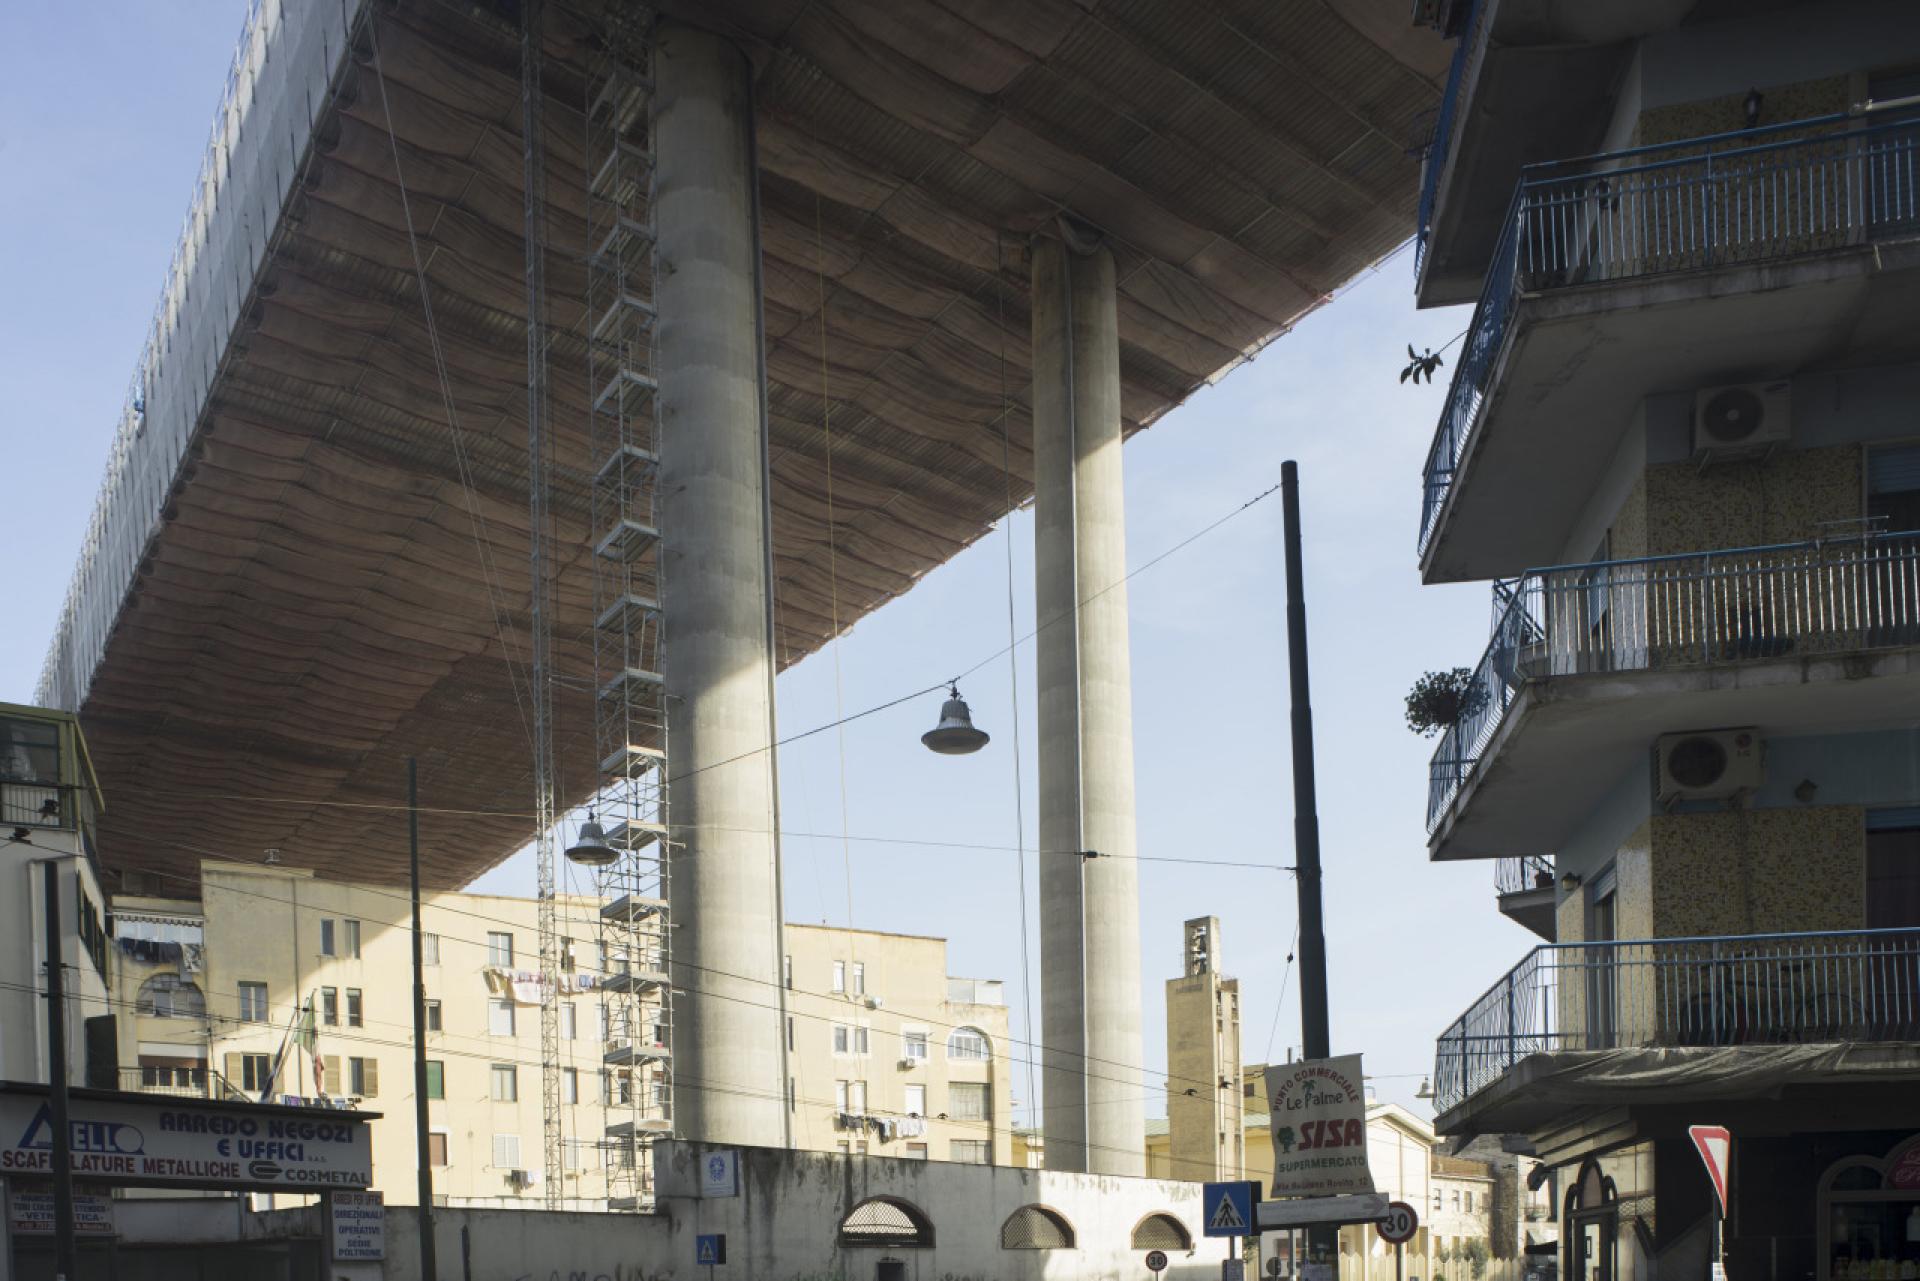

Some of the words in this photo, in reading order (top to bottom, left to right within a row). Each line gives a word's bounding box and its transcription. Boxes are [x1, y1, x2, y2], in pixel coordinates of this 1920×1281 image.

[1273, 1080, 1294, 1111] PUNTO
[1294, 1067, 1359, 1104] COMMERCIALE
[1287, 1097, 1302, 1111] Le
[1304, 1091, 1344, 1109] Palme
[159, 1112, 258, 1136] ARREDO
[269, 1119, 353, 1143] NEGOZI
[1298, 1118, 1363, 1151] SISA
[217, 1138, 230, 1157] E
[237, 1139, 304, 1161] UFFICI
[2, 1149, 136, 1174] SCAFLATURE
[144, 1158, 240, 1178] METALLICHE
[1279, 1156, 1366, 1172] SUPERMERCATO
[285, 1168, 369, 1184] COSMETAL
[1385, 1213, 1408, 1232] 30
[339, 1247, 382, 1257] POLTRONE
[1150, 1256, 1163, 1265] 30
